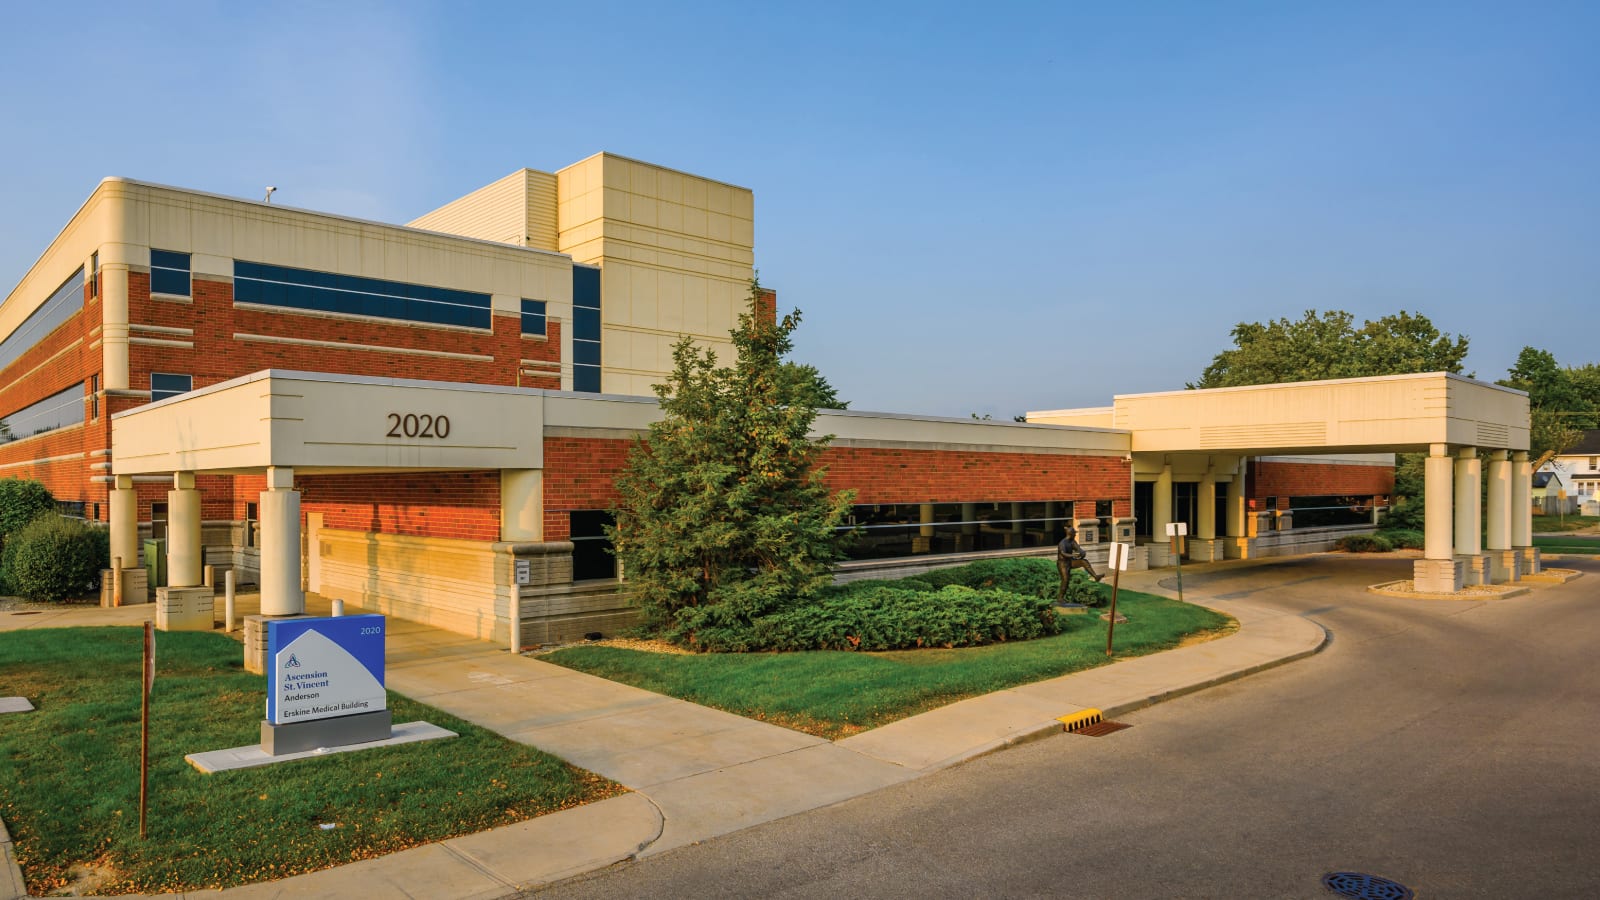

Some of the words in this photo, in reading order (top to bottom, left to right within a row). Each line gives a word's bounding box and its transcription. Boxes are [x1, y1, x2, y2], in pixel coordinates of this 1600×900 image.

[386, 413, 450, 438] 2020
[360, 626, 381, 635] 2020
[285, 671, 328, 681] Ascension
[284, 683, 296, 691] St.
[296, 680, 329, 690] Vincent
[284, 692, 320, 702] Anderson
[284, 707, 310, 717] Erskine
[312, 704, 340, 713] Medical
[342, 701, 369, 710] Building
